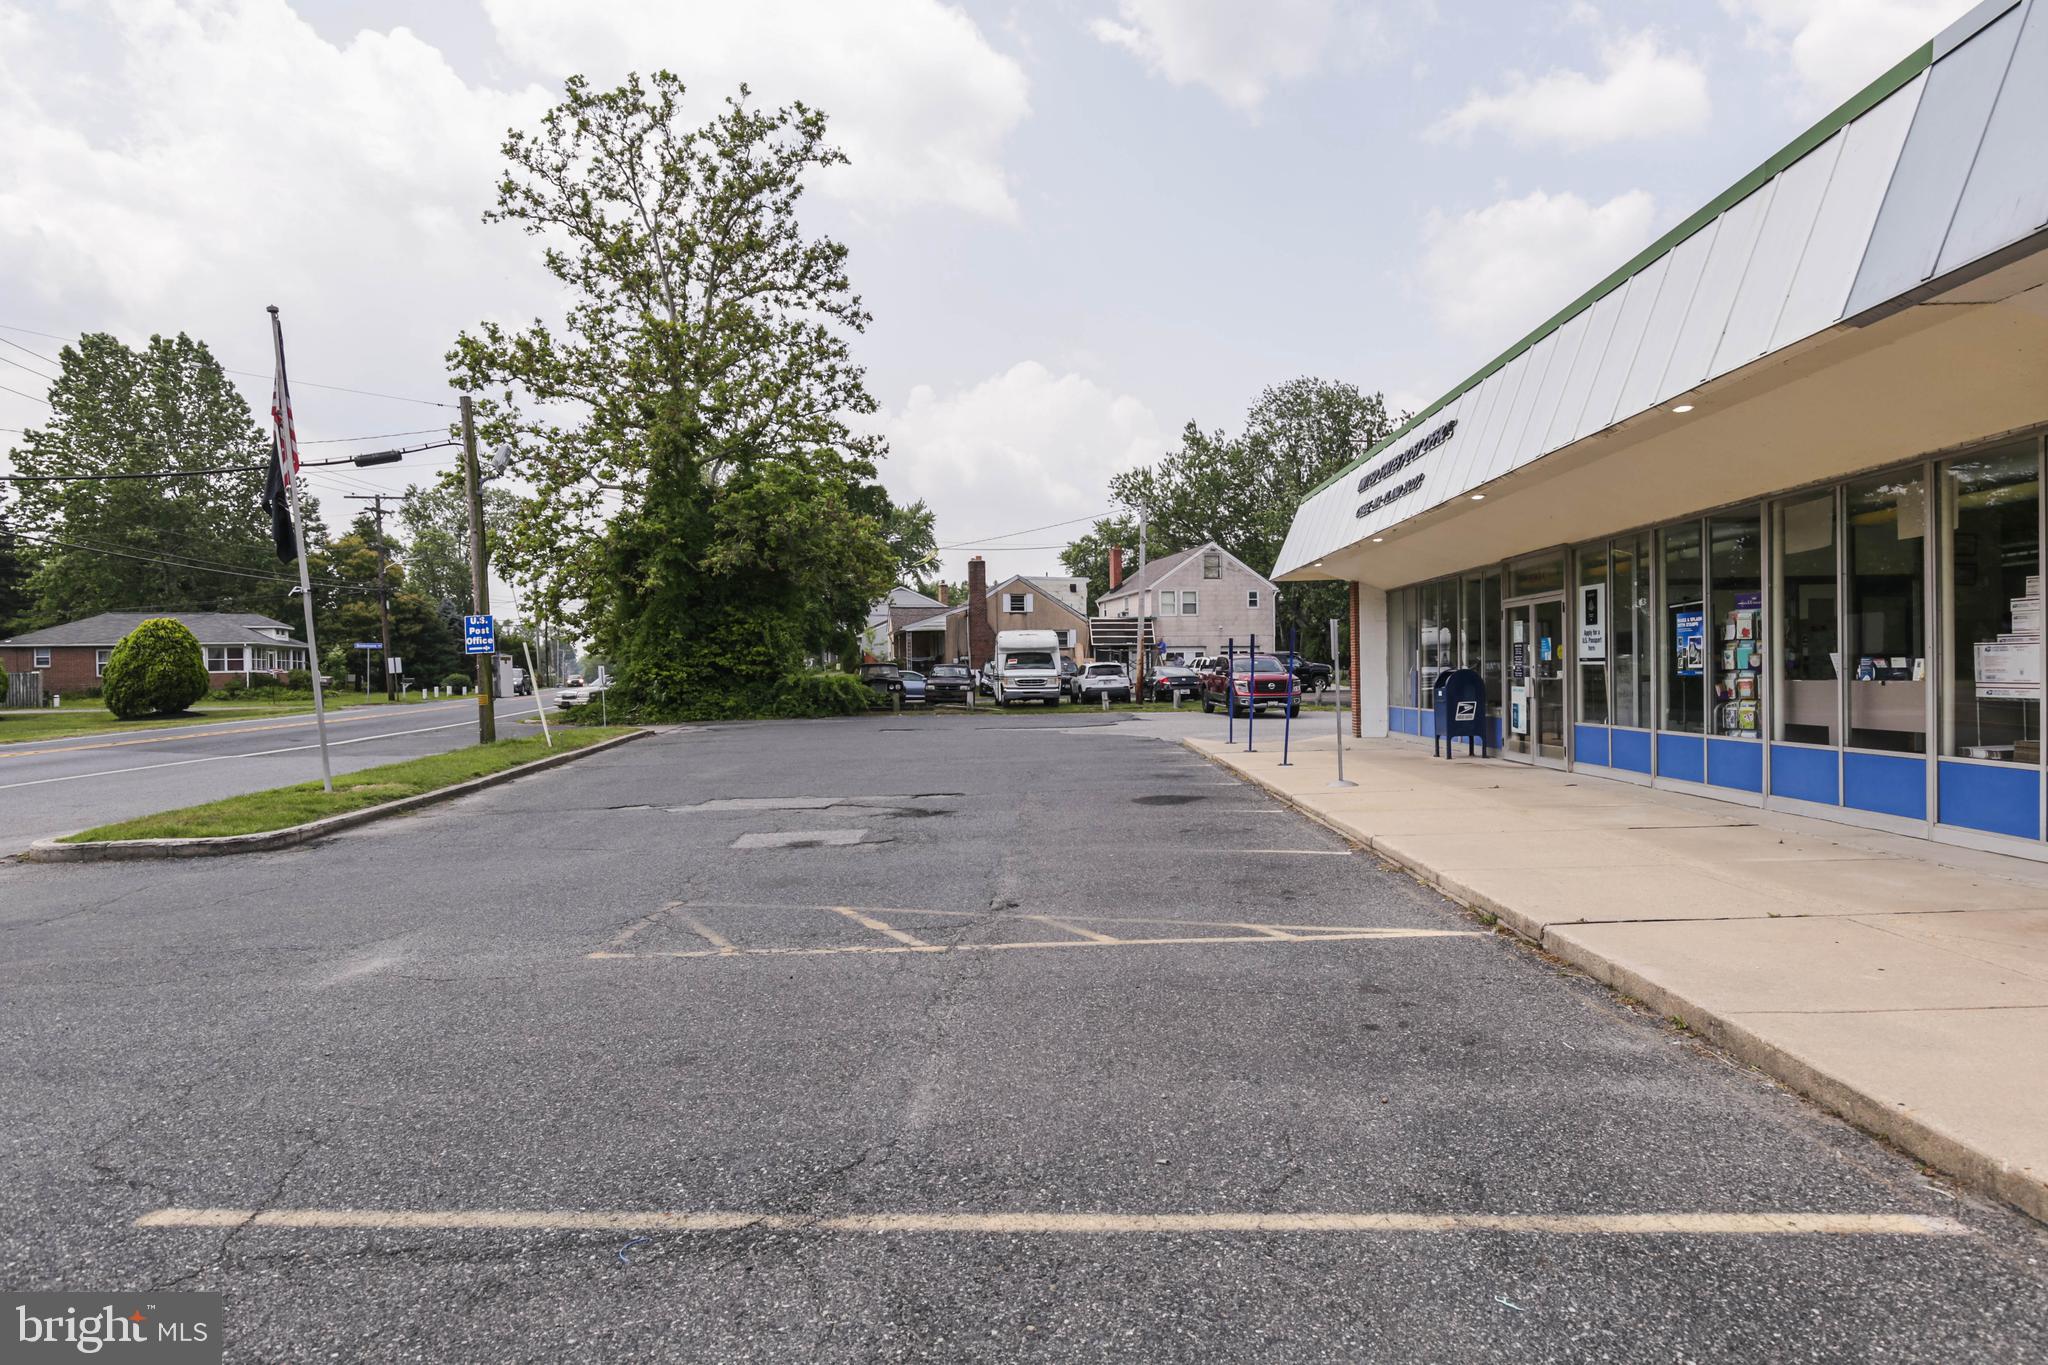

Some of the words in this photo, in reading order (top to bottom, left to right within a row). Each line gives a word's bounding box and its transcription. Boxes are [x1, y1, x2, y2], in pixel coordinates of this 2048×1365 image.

[470, 616, 488, 625] U.S.
[469, 627, 490, 635] Post
[466, 636, 494, 645] Office
